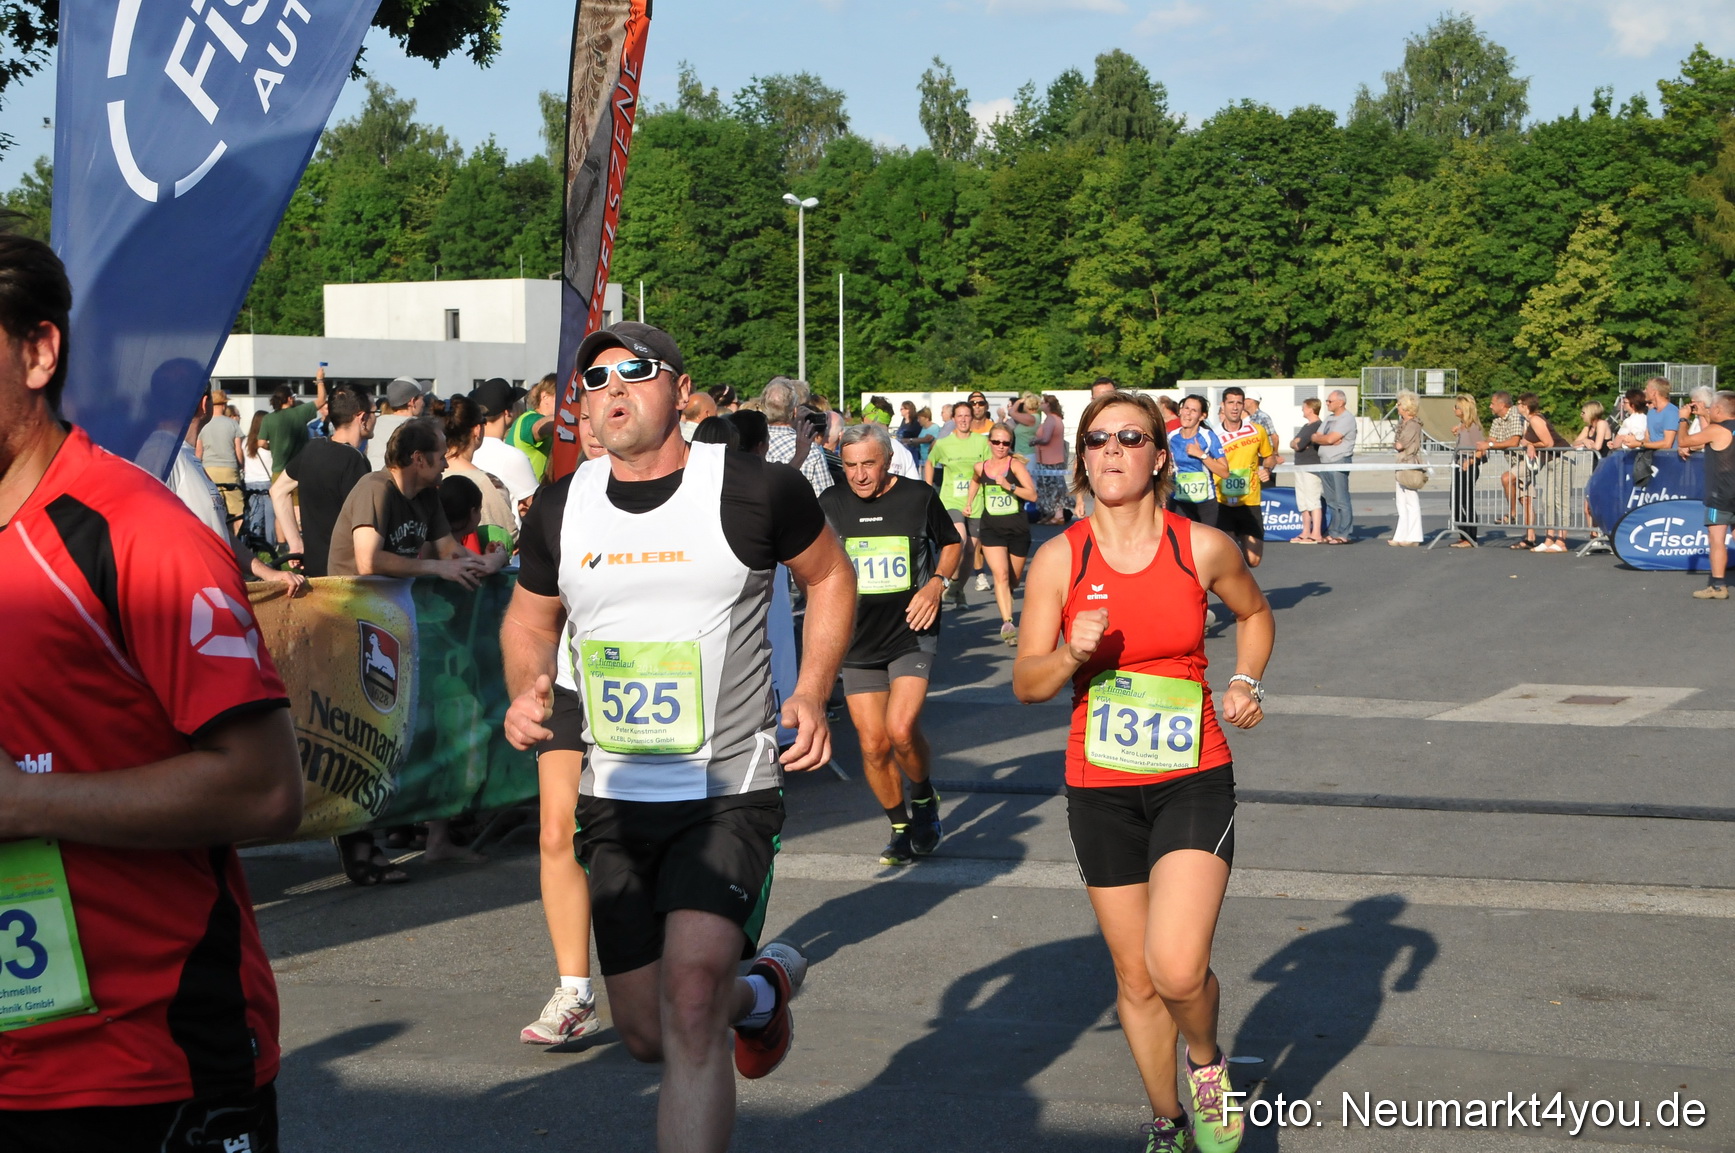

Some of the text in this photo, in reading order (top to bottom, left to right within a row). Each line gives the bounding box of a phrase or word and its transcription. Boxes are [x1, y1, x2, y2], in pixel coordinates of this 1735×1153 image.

[1177, 482, 1206, 495] 1037
[1225, 478, 1246, 490] 809
[989, 495, 1012, 508] 730
[607, 550, 693, 565] KLEBL
[851, 556, 907, 579] 1116
[1086, 592, 1109, 600] erima
[370, 686, 389, 706] 1628
[601, 680, 681, 725] 525
[615, 726, 667, 735] Peter Kunstmann
[1092, 703, 1193, 753] 1318
[610, 735, 626, 743] KLEBL
[1090, 751, 1119, 762] Sparkasse
[1120, 748, 1159, 760] Karo Ludwig
[0, 908, 49, 980] 3
[25, 998, 54, 1010] GmbH
